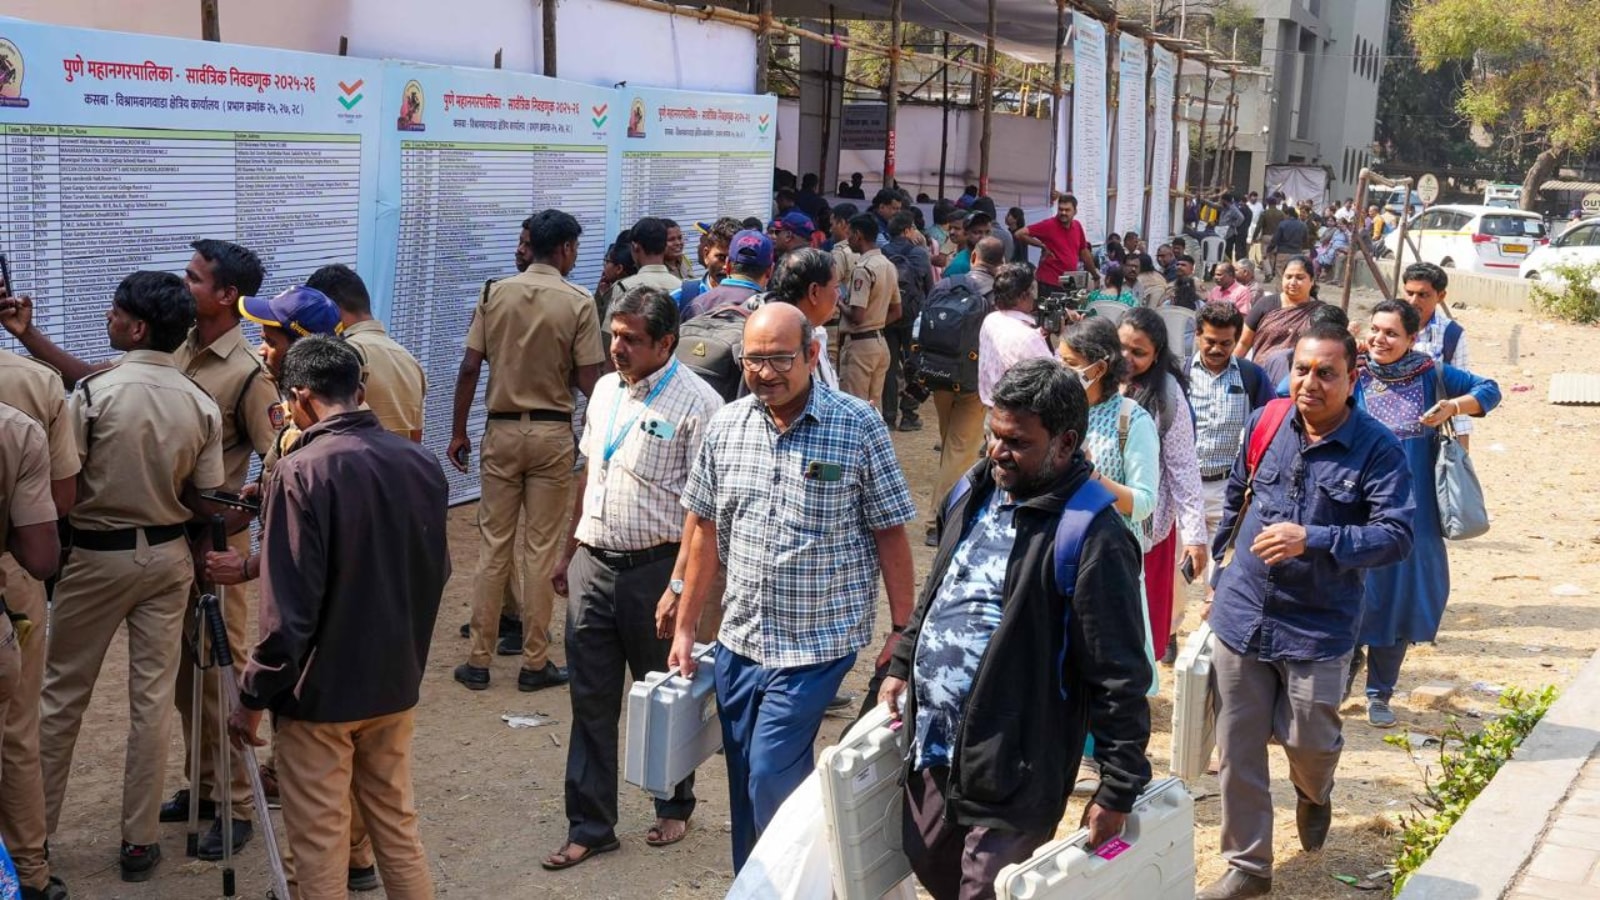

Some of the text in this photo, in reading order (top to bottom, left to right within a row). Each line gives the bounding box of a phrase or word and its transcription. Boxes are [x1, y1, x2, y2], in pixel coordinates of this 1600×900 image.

[63, 54, 84, 82] पुणे
[88, 61, 173, 83] महानगरपालिका
[185, 64, 227, 86] सार्वत्रिक
[230, 67, 271, 94] निवडणूक
[274, 74, 317, 93] २०२५-२६
